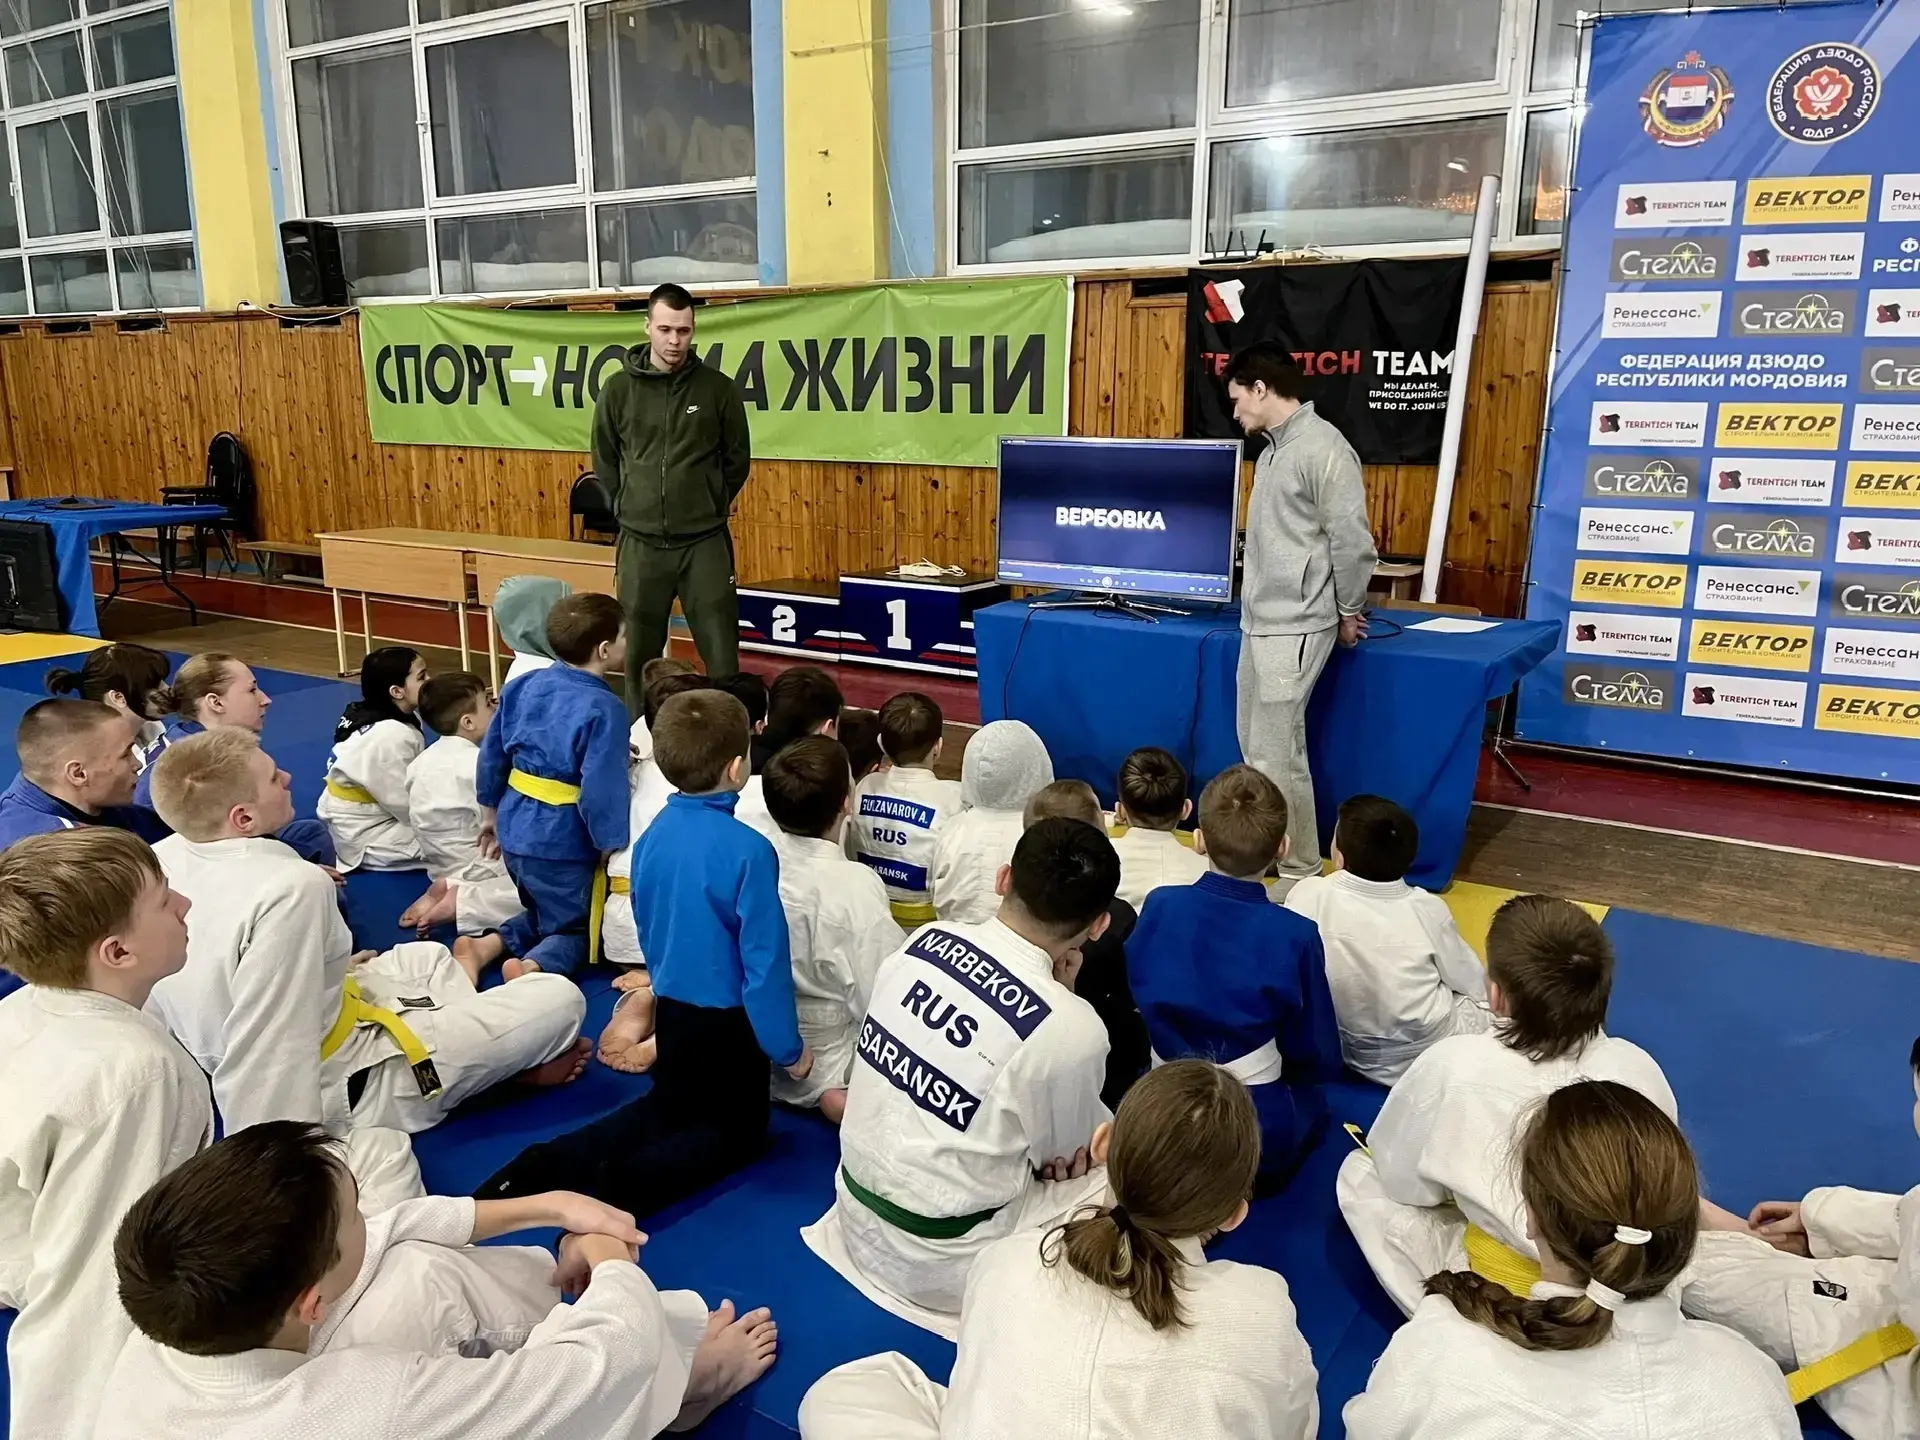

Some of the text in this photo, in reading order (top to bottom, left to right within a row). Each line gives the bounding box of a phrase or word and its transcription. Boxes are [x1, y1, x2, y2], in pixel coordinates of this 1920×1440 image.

[1773, 48, 1875, 122] ФЕДЕРАЦИЯ ДЗЮДО РОССИИ
[1802, 127, 1835, 138] ФДР
[1652, 202, 1701, 210] TERENTICH
[1754, 189, 1866, 207] ВЕКТОР
[1900, 237, 1920, 253] Ф
[1619, 250, 1717, 275] Стелла
[1775, 254, 1855, 263] TERENTICH TEAM
[1613, 307, 1701, 319] Ренессанс.
[1740, 303, 1844, 330] Стелла
[1200, 350, 1455, 376] TEICH TEAM
[1620, 354, 1825, 371] ФЕДЕРАЦИЯ ДЗЮДО
[375, 334, 1045, 415] СПОРТ НОА ЖИЗНИ
[1596, 373, 1848, 389] РЕСПУБЛИКИ МОРДОВИЯ
[1383, 382, 1440, 390] МЫ ДЕЛАЕМ.
[1368, 401, 1382, 409] WE
[1383, 402, 1397, 410] DO
[1411, 402, 1435, 410] JOIN
[1625, 420, 1699, 429] TERENTICH TEAM
[1725, 414, 1837, 431] ВЕКТОР
[1594, 466, 1689, 494] Стелла
[1747, 477, 1826, 488] TERENTICH TEAM
[1055, 506, 1166, 530] ВЕРБОВКА
[1588, 520, 1673, 535] Ренессанс.
[1712, 523, 1815, 553] Стелла
[1581, 571, 1682, 590] ВЕКТОР
[1706, 578, 1799, 595] Ренессанс.
[772, 604, 796, 642] 2
[886, 599, 912, 651] 1
[1601, 631, 1673, 643] TERENTICH TEAM
[1698, 632, 1808, 652] ВЕКТОР
[1834, 657, 1896, 668] СТРАХОВАНИЕ
[1571, 674, 1664, 706] Стелла
[1719, 694, 1798, 709] TERENTICH TEAM
[872, 827, 907, 846] RUS
[868, 864, 908, 881] ARANSK
[917, 931, 1040, 1019] NARBEKOV
[900, 979, 979, 1048] RUS
[859, 1023, 974, 1126] SARANSK
